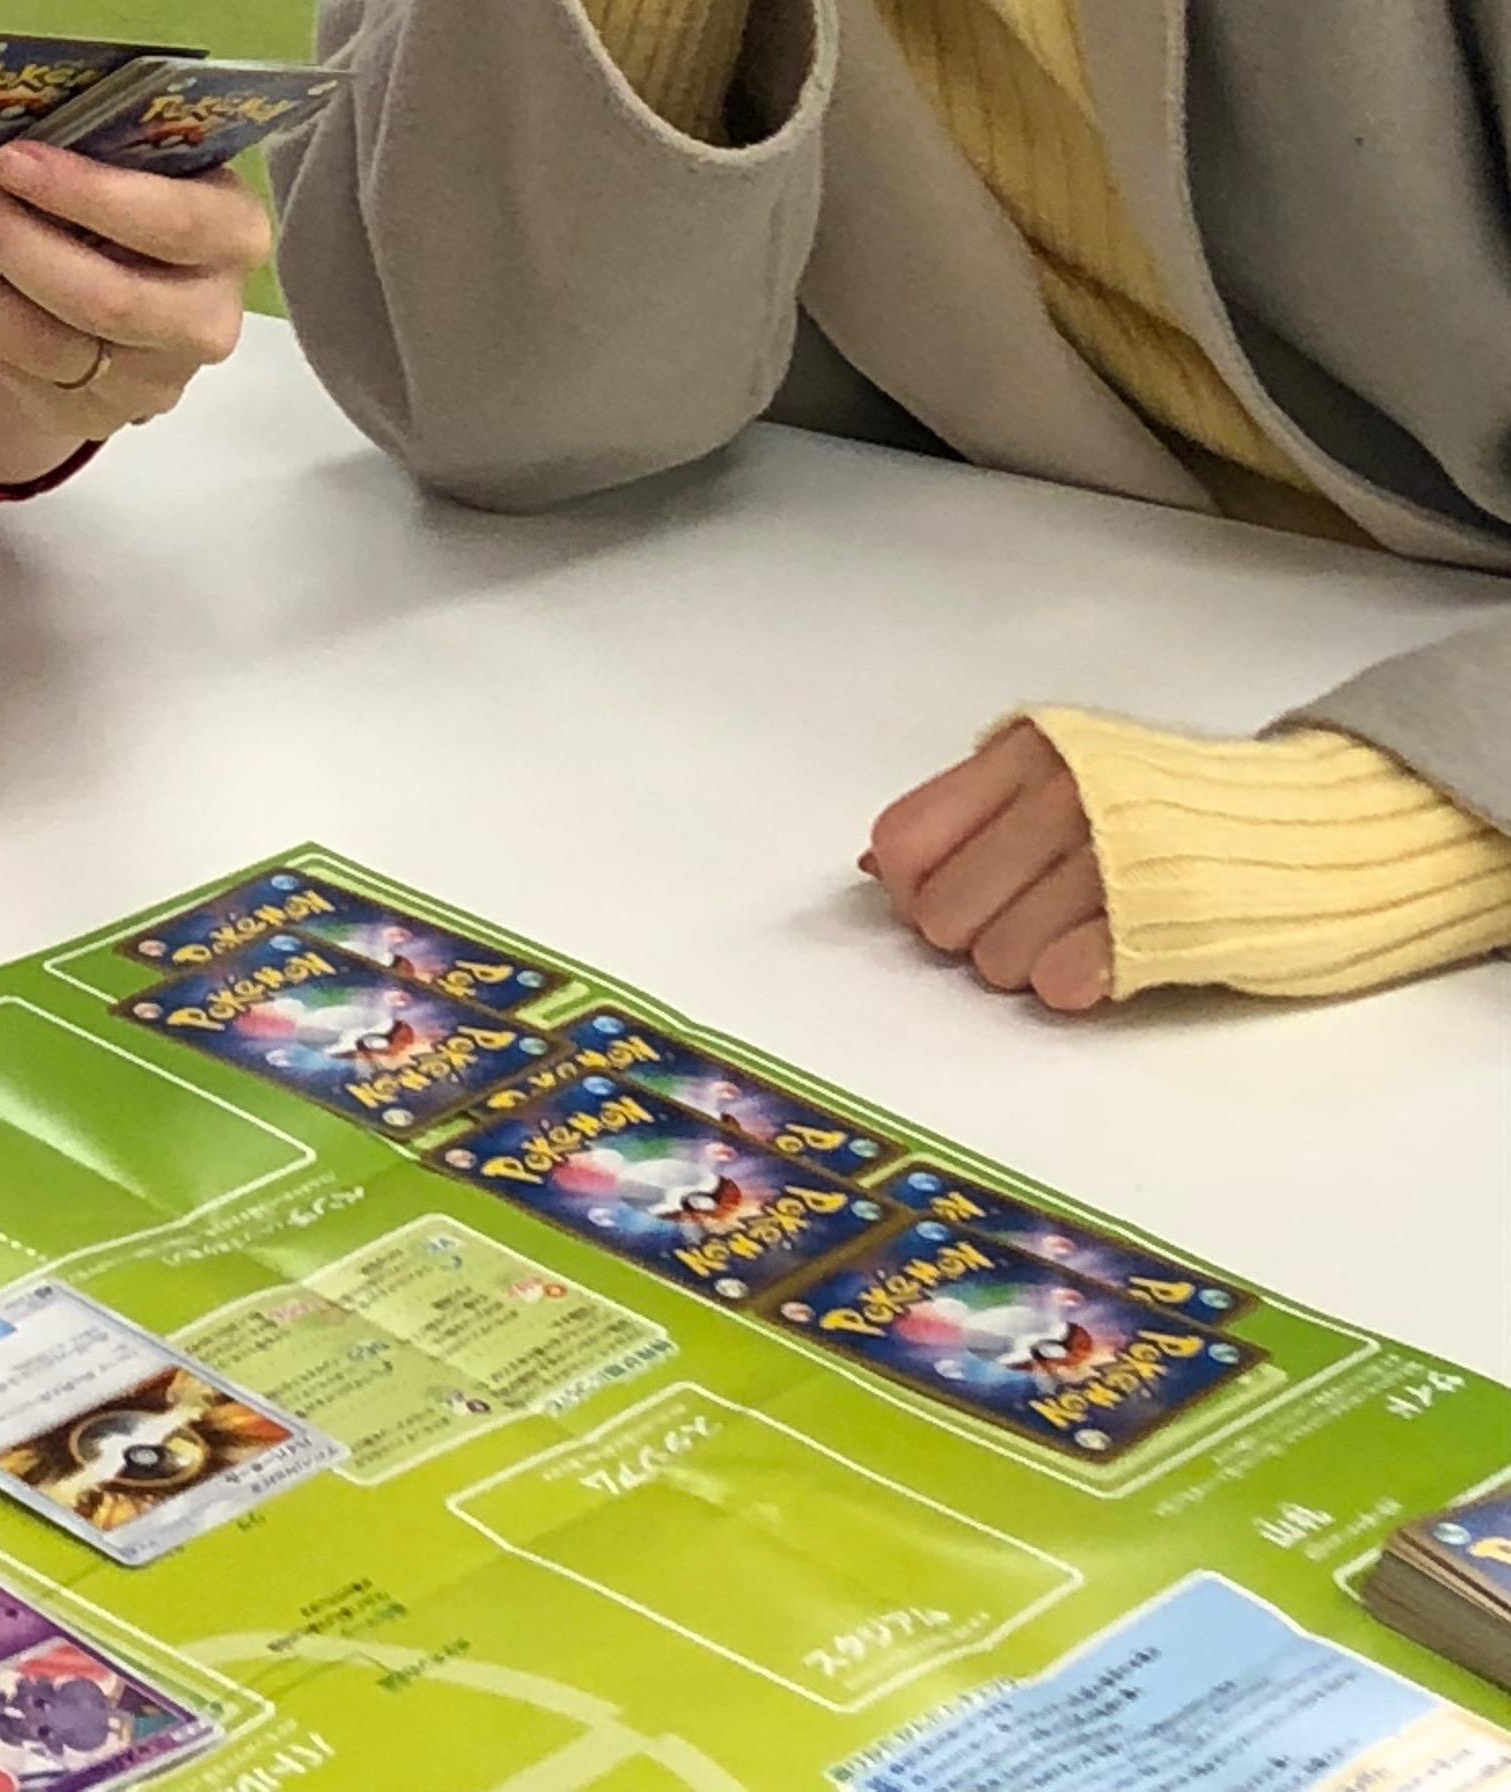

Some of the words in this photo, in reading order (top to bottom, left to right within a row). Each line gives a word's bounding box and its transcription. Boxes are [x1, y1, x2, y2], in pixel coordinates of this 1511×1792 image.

[802, 1607, 951, 1677] スタジアム
